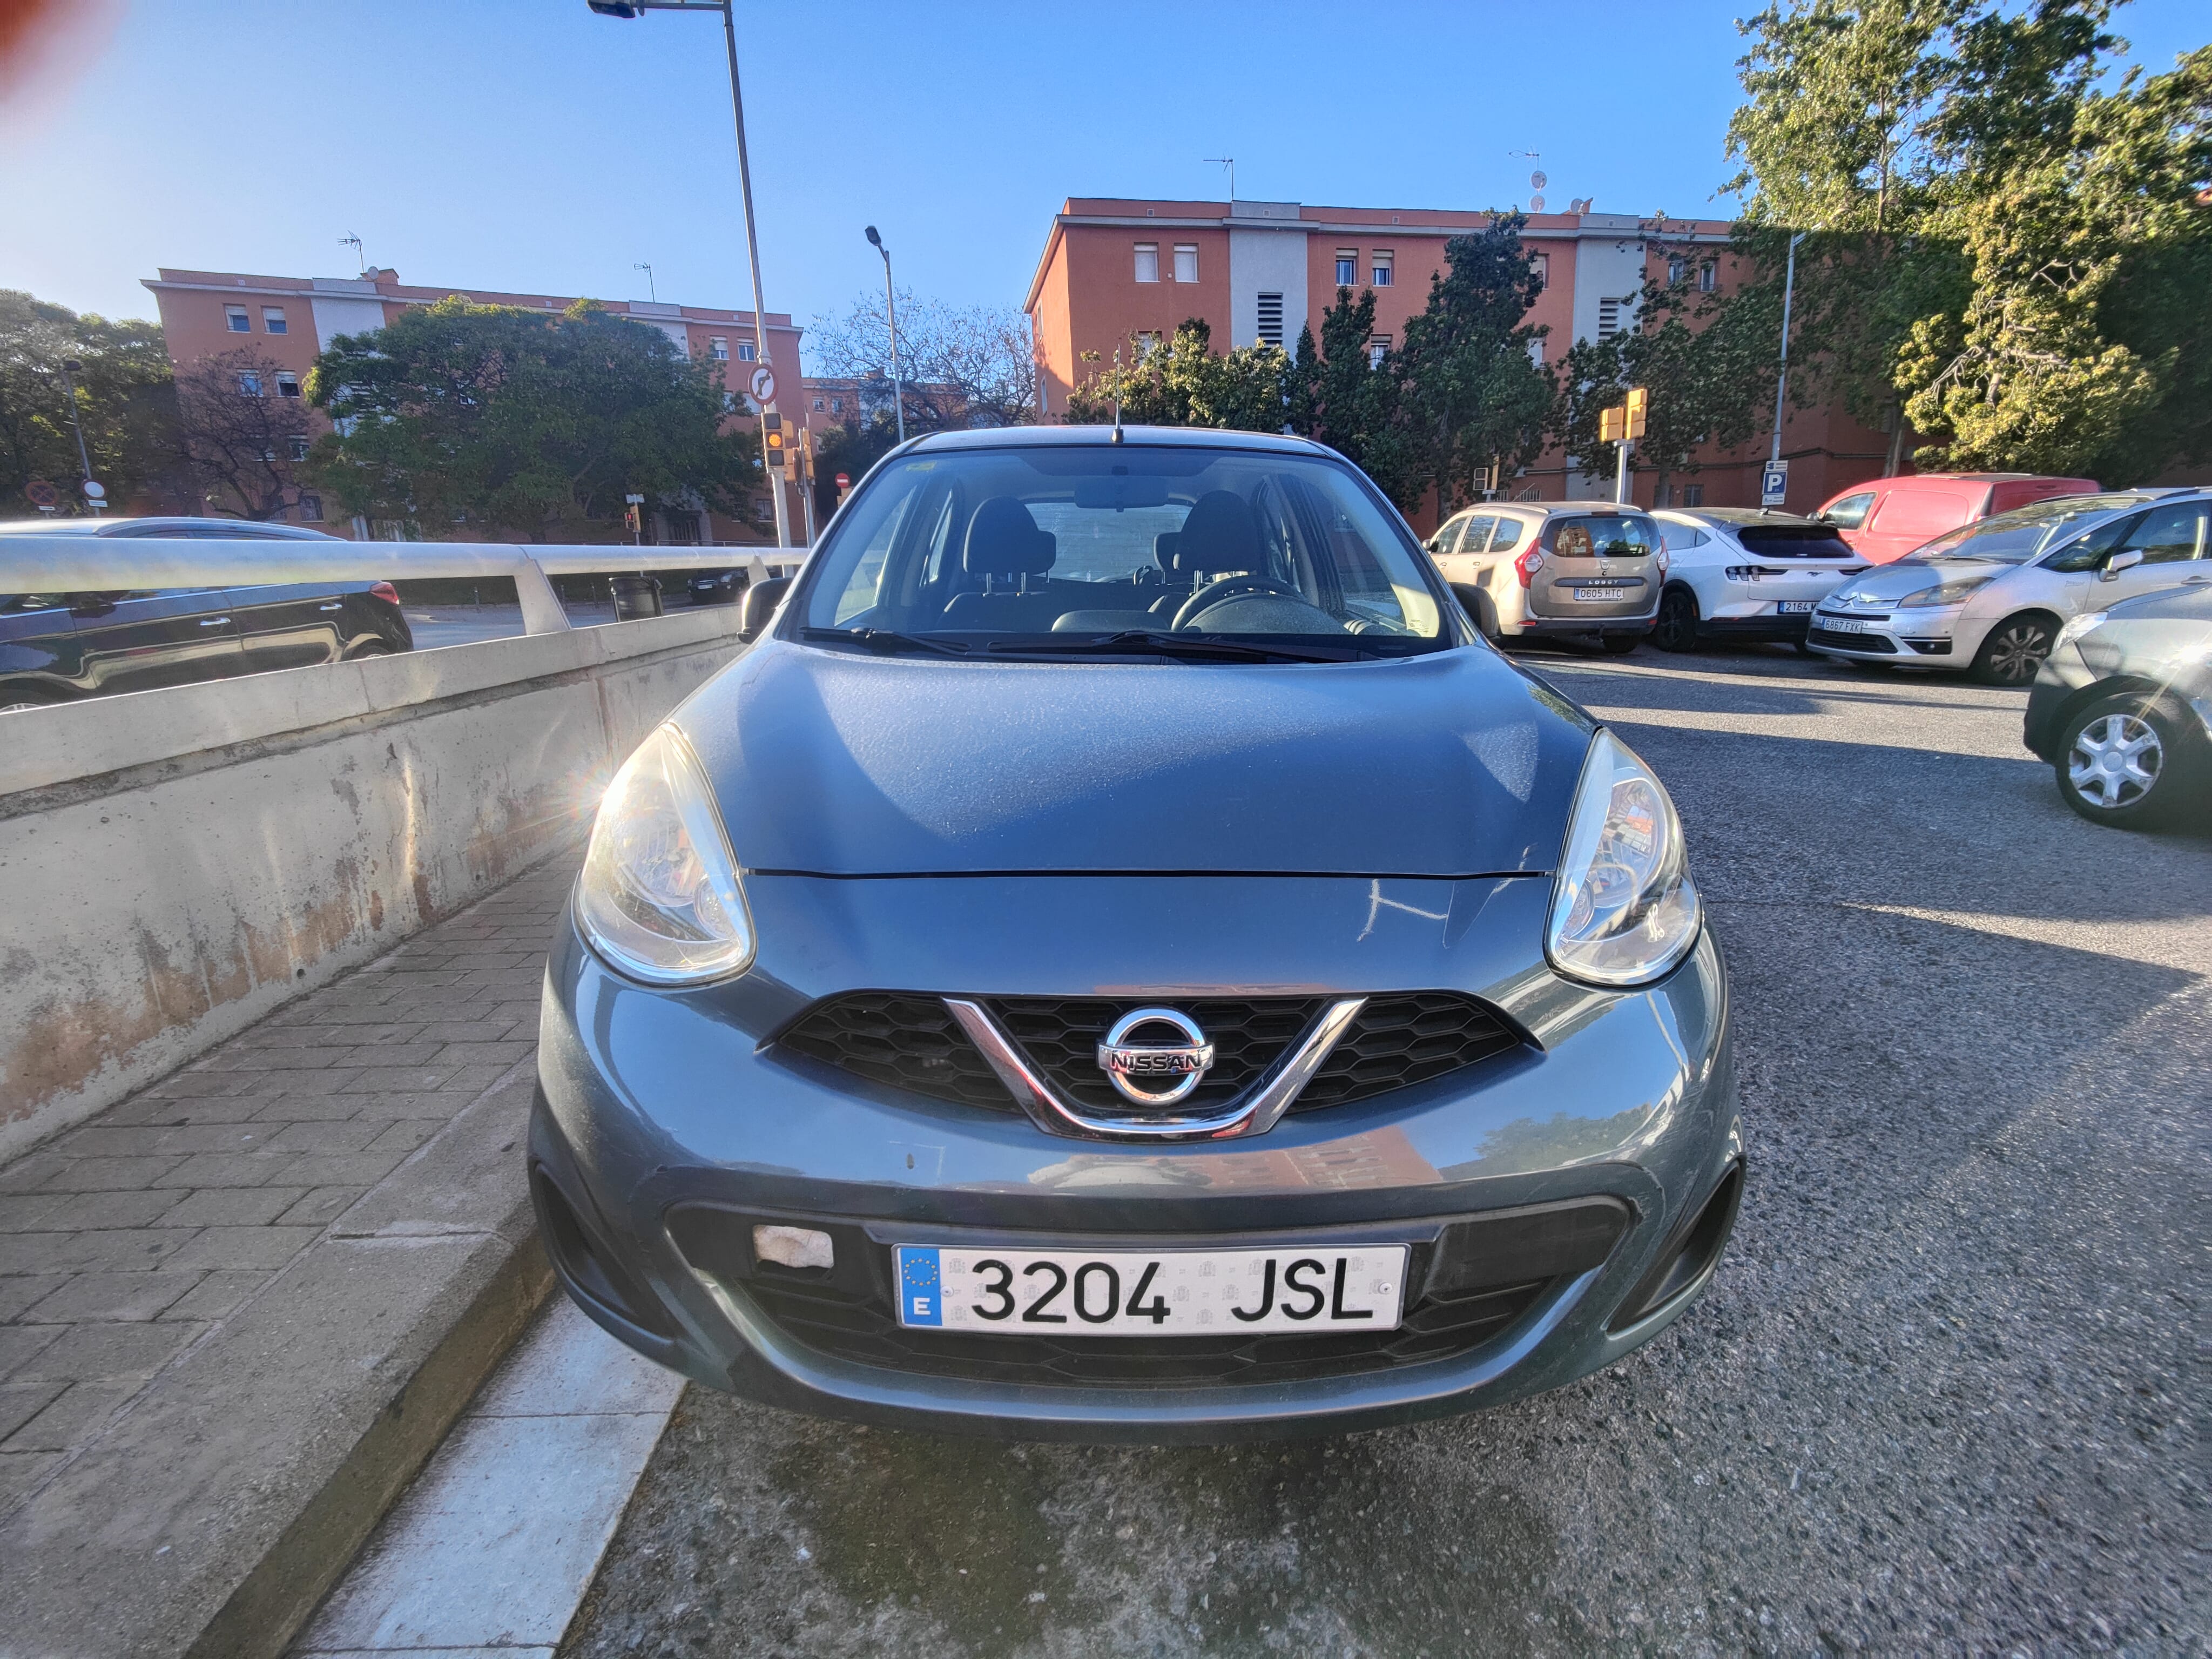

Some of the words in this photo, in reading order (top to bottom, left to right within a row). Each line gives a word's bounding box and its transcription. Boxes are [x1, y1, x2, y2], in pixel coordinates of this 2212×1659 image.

[1767, 474, 1782, 492] P
[1581, 589, 1602, 597] 0605
[1606, 589, 1621, 597] HTC
[1786, 603, 1808, 611] 2164
[1825, 620, 1844, 630] 6867
[1845, 622, 1860, 632] FXK
[1111, 1054, 1202, 1070] NISSAN
[972, 1259, 1171, 1324] 3204
[1231, 1257, 1373, 1322] JSL
[913, 1297, 930, 1316] E
